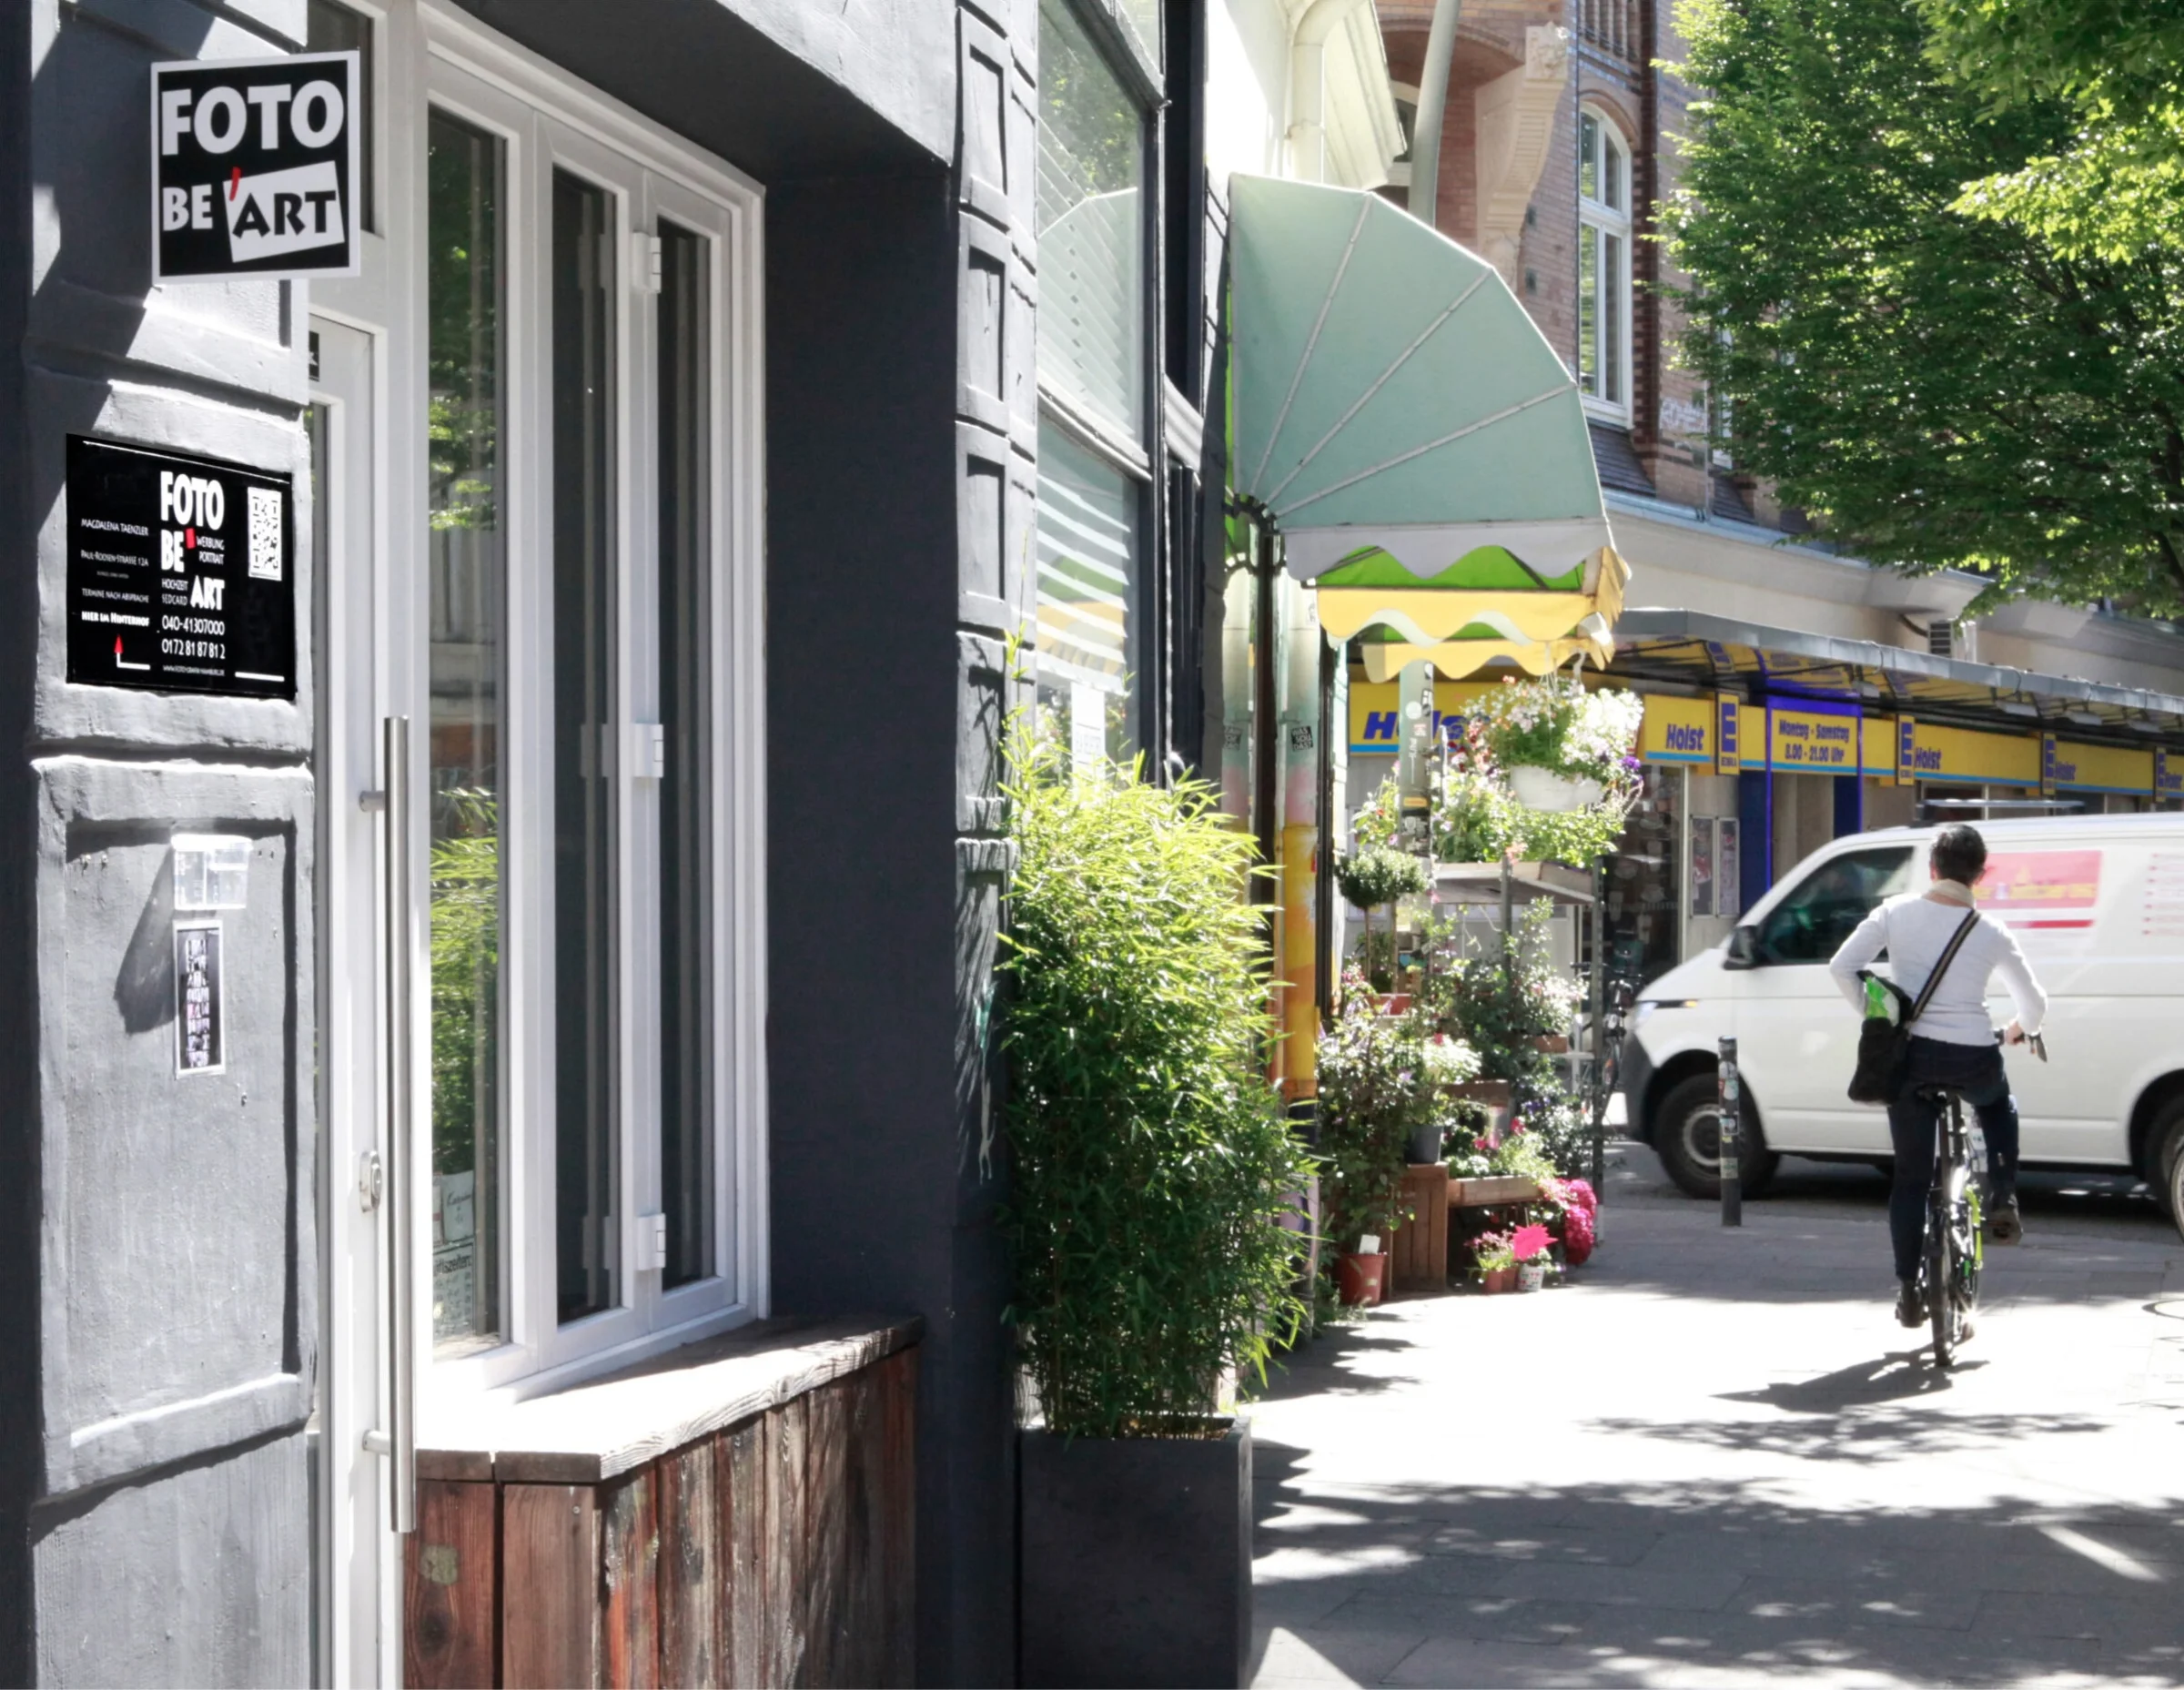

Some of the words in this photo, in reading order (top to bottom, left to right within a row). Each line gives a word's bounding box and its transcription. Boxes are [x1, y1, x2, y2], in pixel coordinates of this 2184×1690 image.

[162, 80, 344, 156] FOTO
[163, 184, 213, 231] BE
[160, 471, 225, 530] FOTO
[81, 518, 119, 531] MAGDALENA
[120, 523, 148, 536] TAENZLER
[161, 529, 185, 572] BE
[197, 536, 225, 551] WERBUNG
[199, 552, 225, 565] PORTRAIT
[82, 587, 105, 599] TERMINE
[106, 591, 120, 600] NACH
[161, 578, 188, 592] HOCHZEIT
[190, 575, 225, 611] ART
[81, 611, 98, 622] HIER
[110, 612, 150, 627] HINTERHOF
[161, 614, 225, 635] 040-41307000
[161, 638, 184, 655] 0172
[1665, 724, 1704, 751] Holst
[1779, 719, 1809, 741] Montag
[1816, 724, 1849, 744] Samstag
[1831, 747, 1845, 763] Uhr
[1915, 747, 1942, 770] Holst
